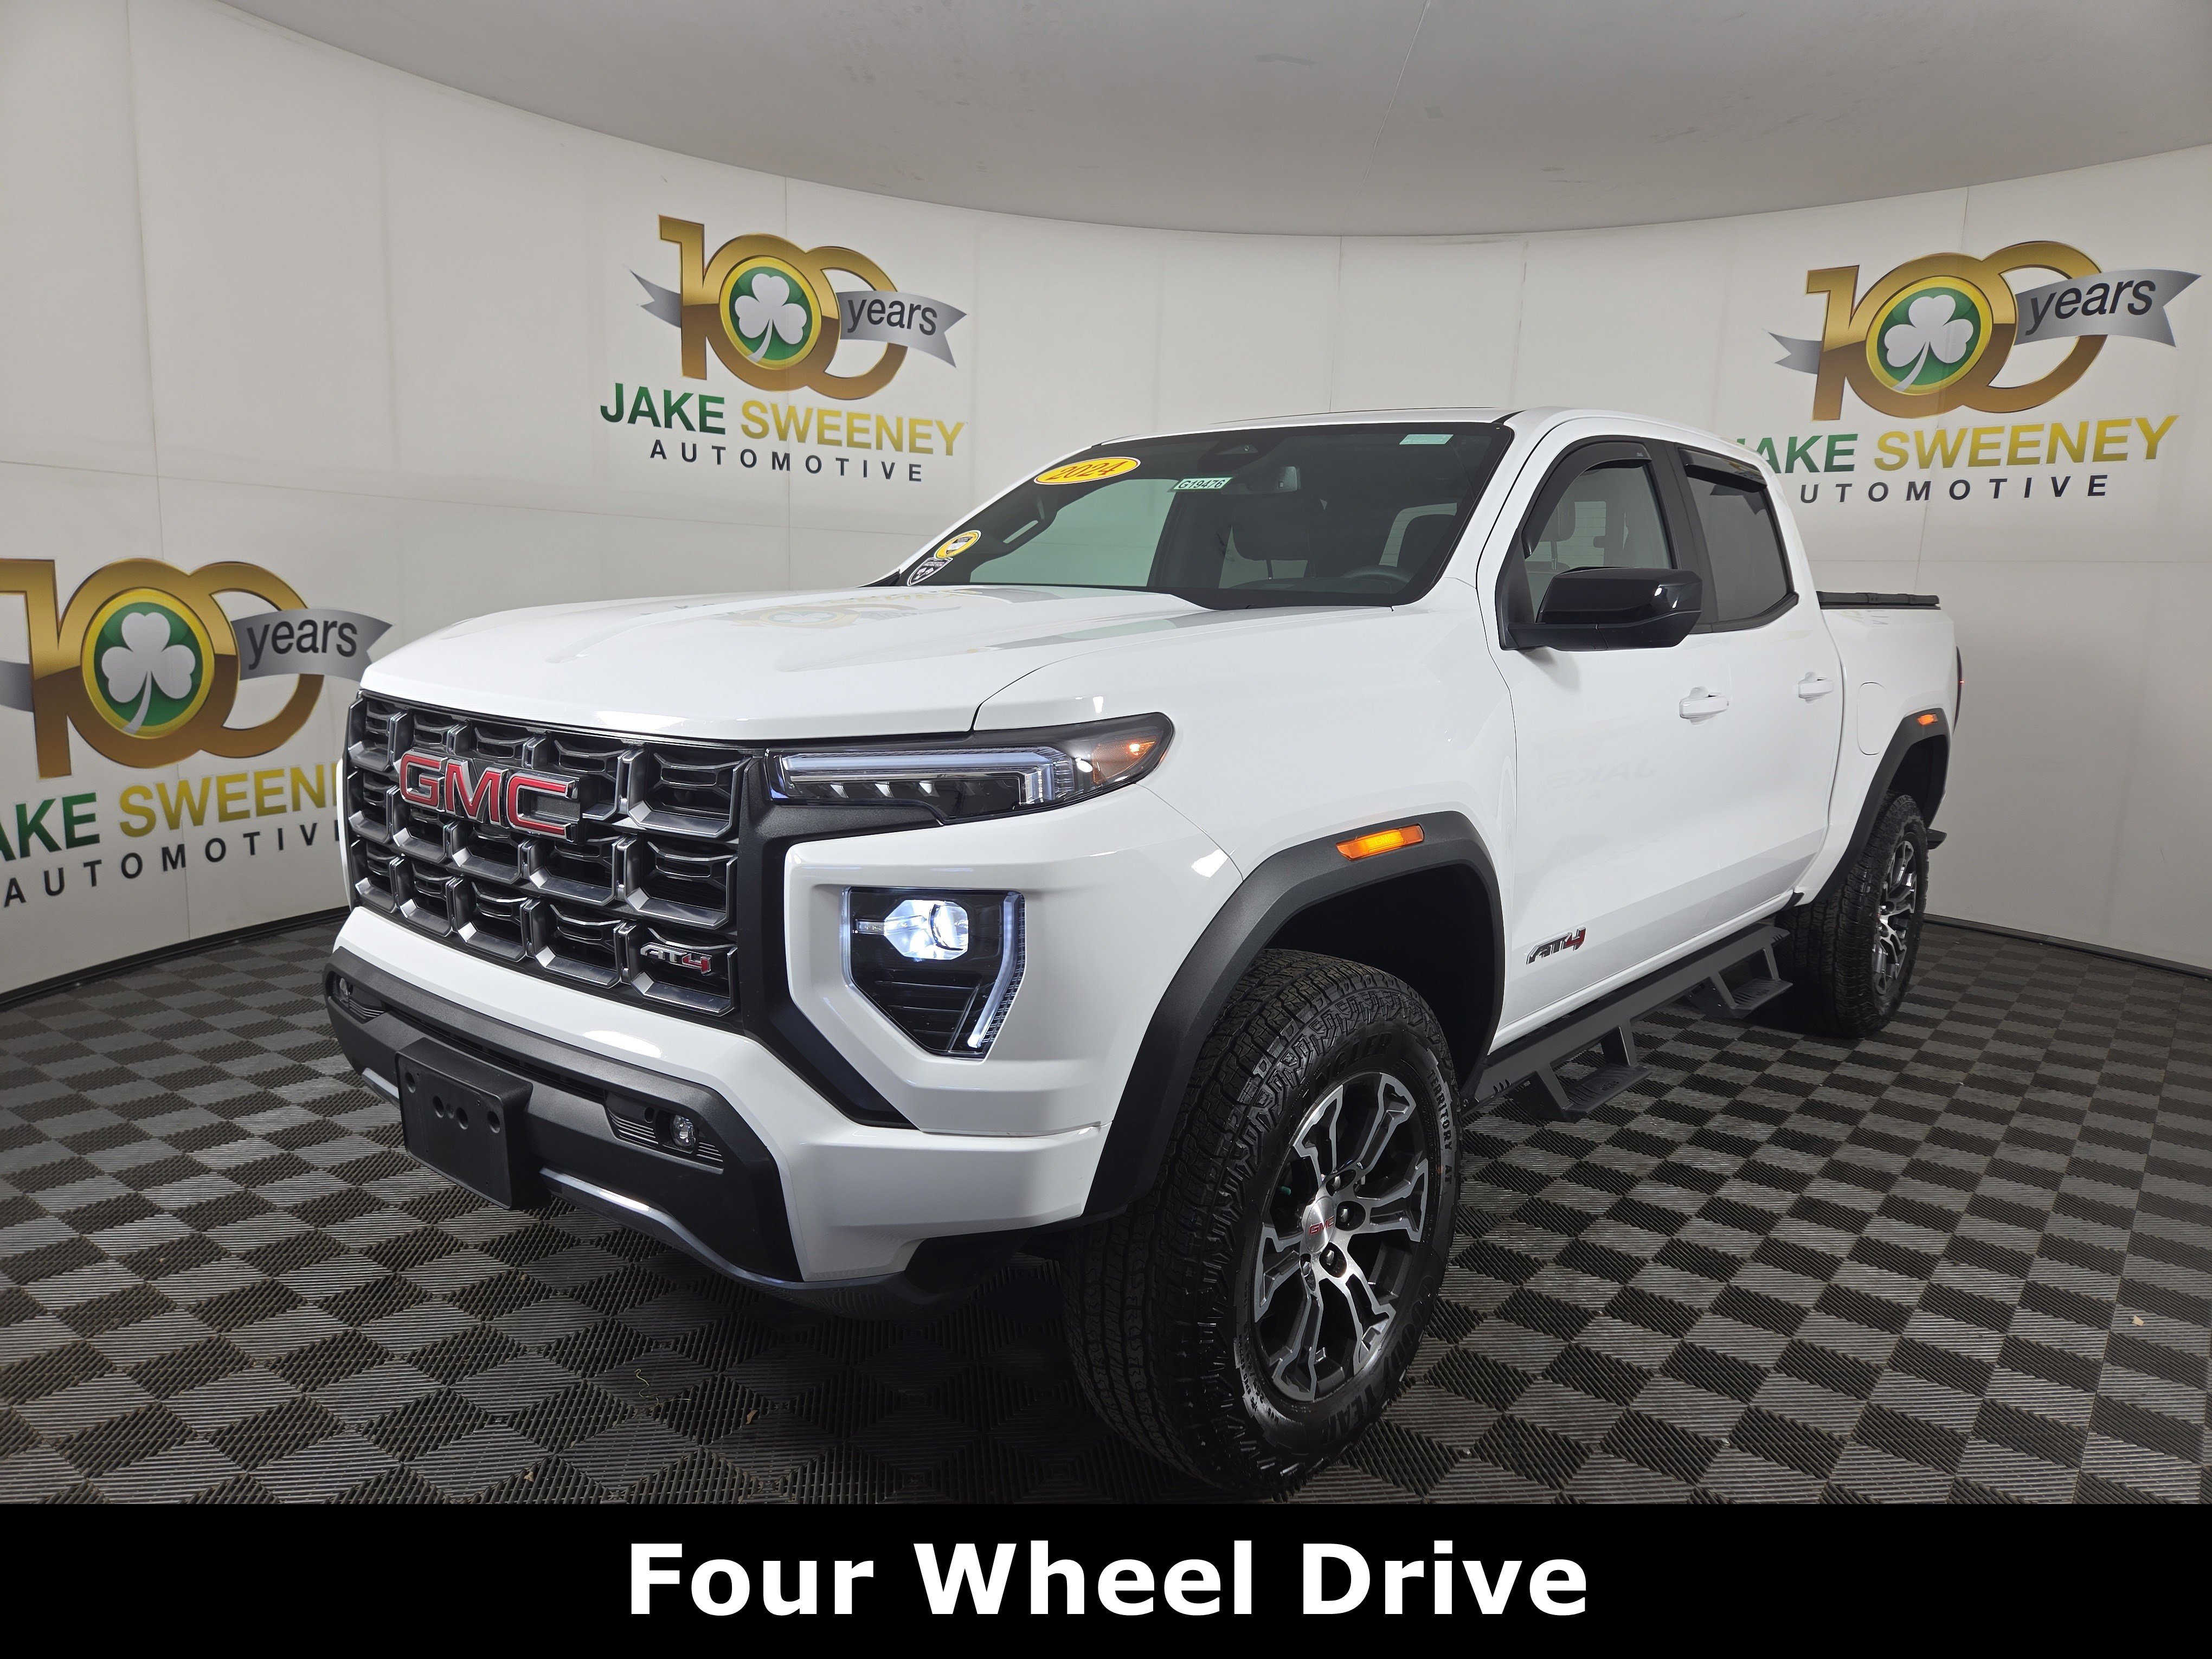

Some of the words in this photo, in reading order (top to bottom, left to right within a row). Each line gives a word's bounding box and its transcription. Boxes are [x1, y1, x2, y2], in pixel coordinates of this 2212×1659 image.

[658, 215, 909, 401] 100
[847, 298, 937, 336] years
[1806, 240, 2108, 421] 100
[2025, 278, 2156, 336] years
[600, 383, 726, 435] JAKE
[741, 400, 965, 456] SWEENEY
[1737, 434, 1859, 474] AKE
[1874, 415, 2180, 471] SWEENEY
[650, 440, 922, 481] AUTOMOTIVE
[1045, 460, 1128, 481] 2024
[1178, 479, 1225, 488] G19476
[1800, 474, 2108, 504] UTOMOTIVE
[247, 619, 358, 671] years
[0, 792, 100, 862] KE
[119, 762, 337, 838] SWEEN
[399, 749, 577, 843] GMC
[640, 943, 712, 975] AT4
[1526, 927, 1586, 965] AT4
[1427, 1069, 1453, 1150] TERRITORY
[1309, 1216, 1334, 1234] GMC
